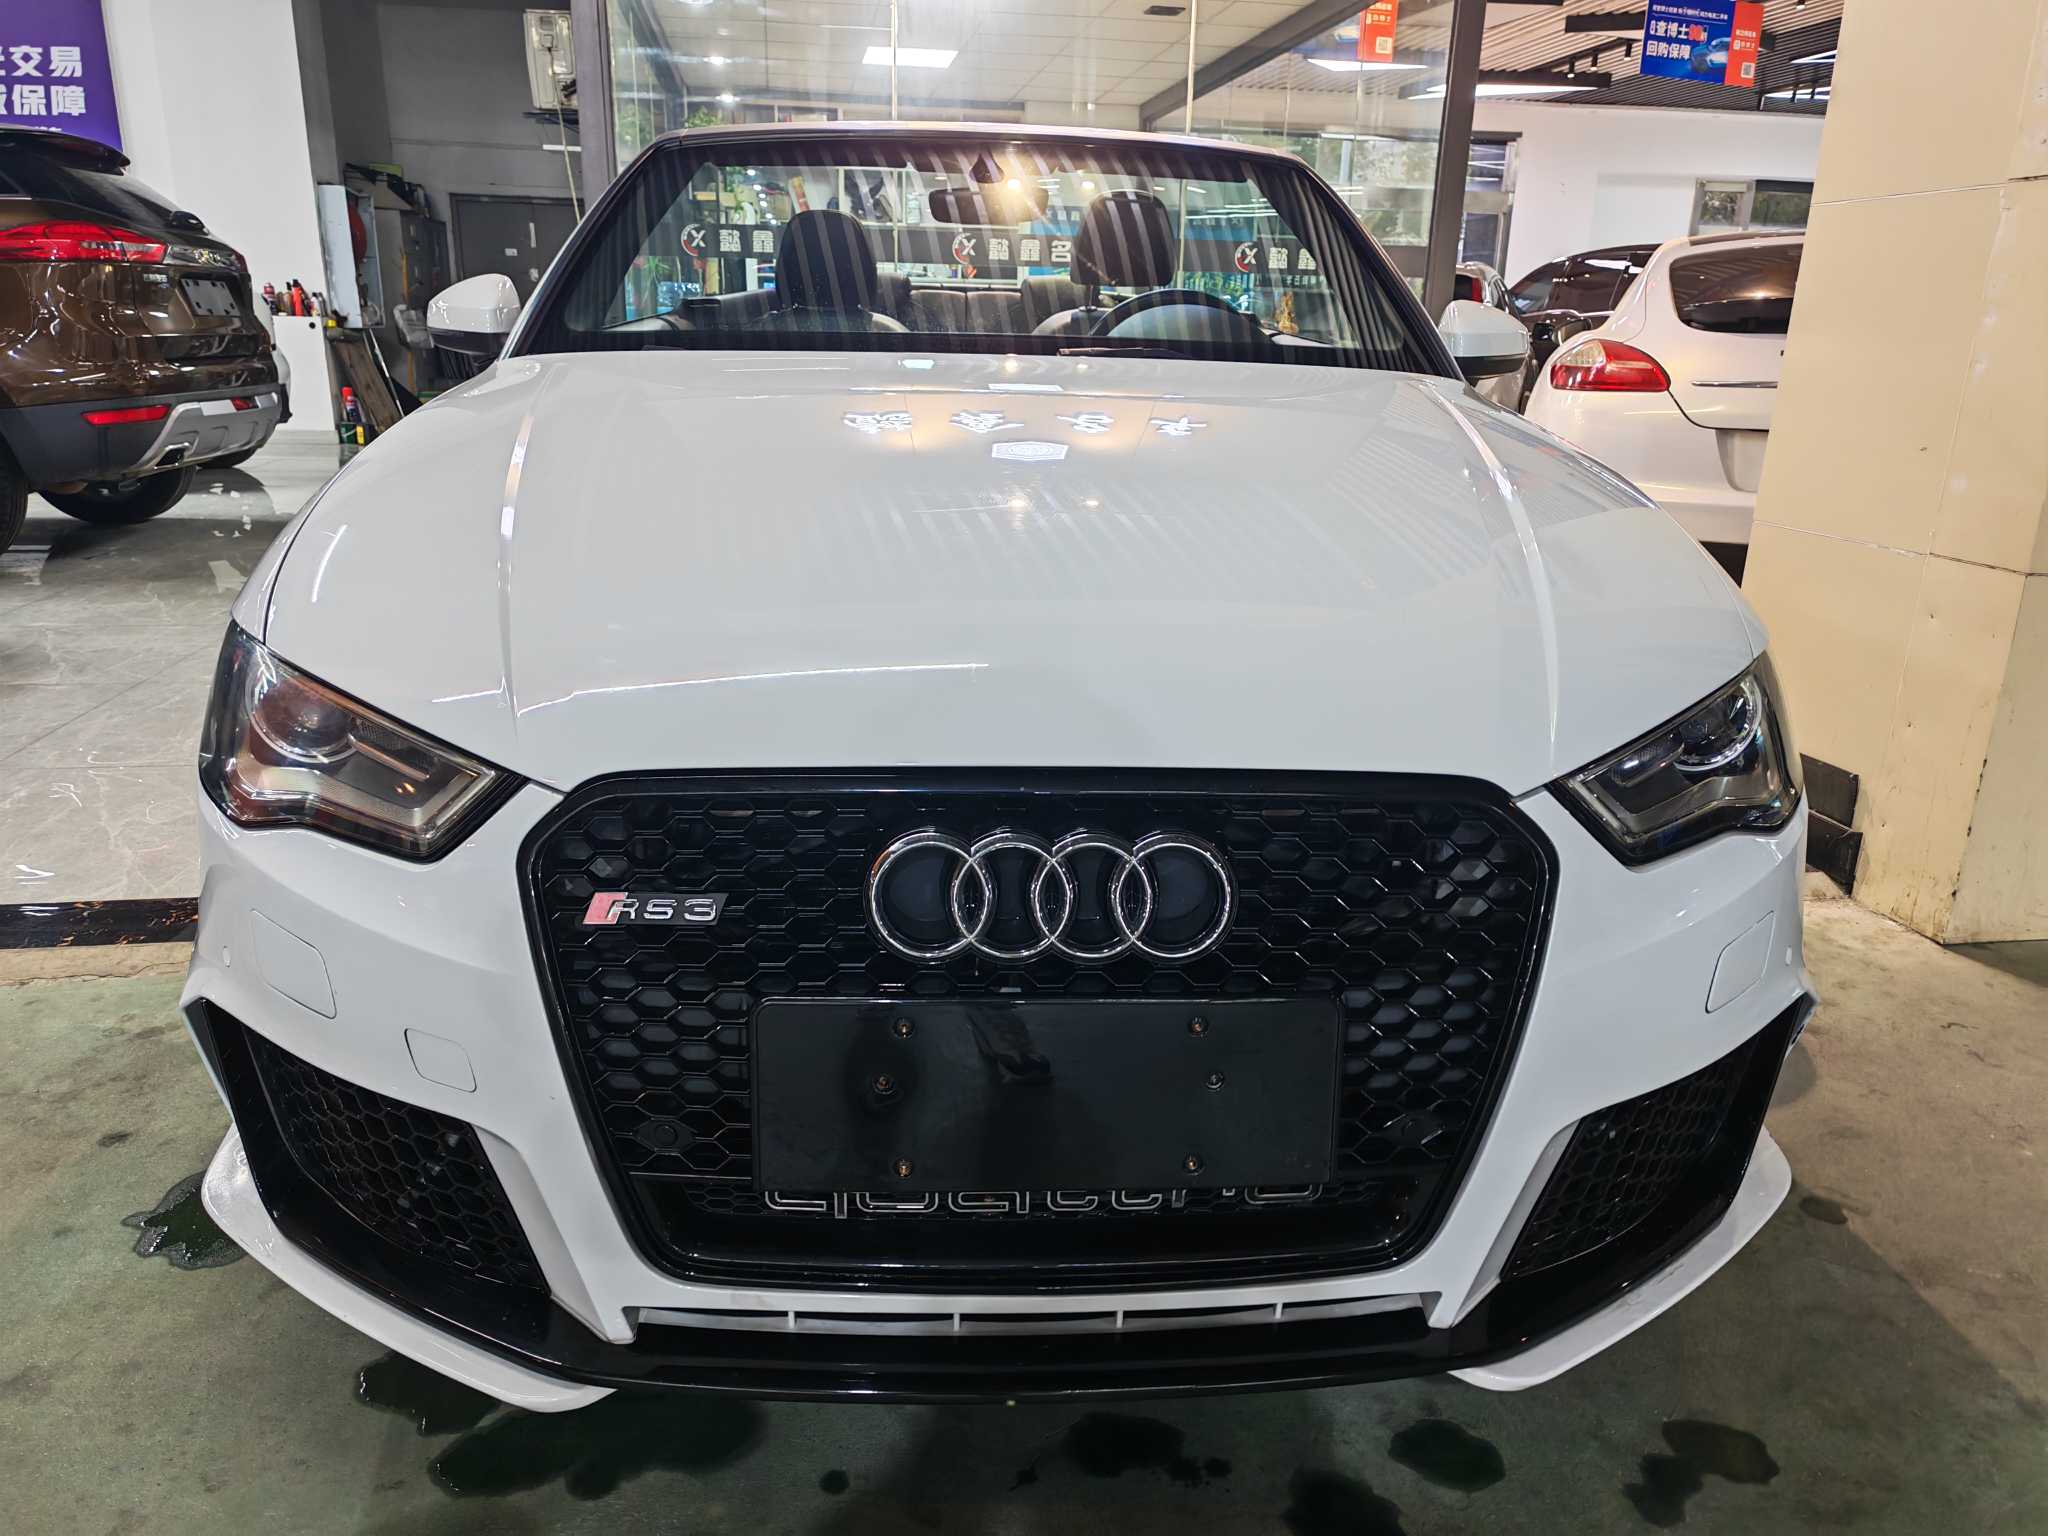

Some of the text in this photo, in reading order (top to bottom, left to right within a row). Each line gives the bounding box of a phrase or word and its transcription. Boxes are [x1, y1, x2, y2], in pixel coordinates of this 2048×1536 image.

[0, 45, 83, 77] 交易
[1646, 40, 1691, 60] 回购保障
